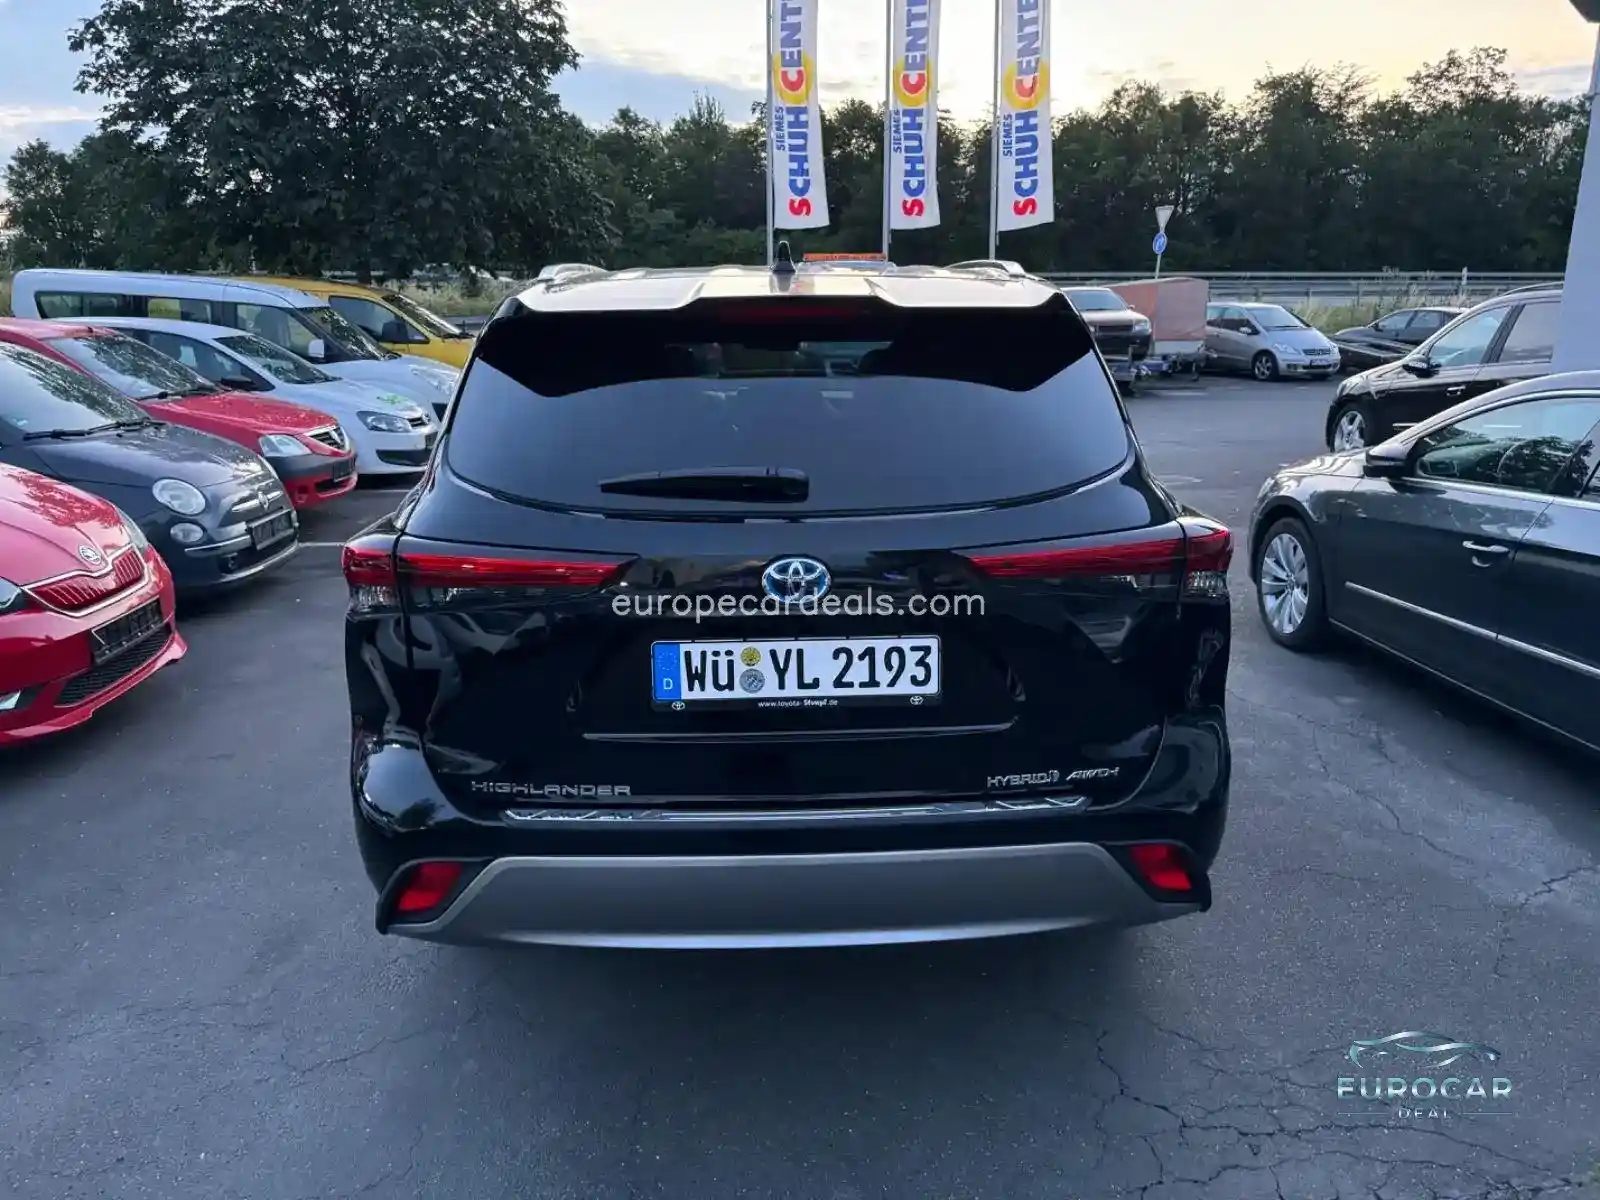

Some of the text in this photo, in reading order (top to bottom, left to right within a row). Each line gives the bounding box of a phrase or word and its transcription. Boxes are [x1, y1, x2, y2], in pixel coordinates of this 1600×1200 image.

[774, 106, 786, 151] SIEMES
[893, 109, 903, 153] SIEMES
[1003, 114, 1013, 157] SIEMES
[662, 678, 674, 690] D
[769, 648, 820, 690] YL
[832, 645, 932, 688] 2193
[471, 780, 631, 797] HIGHLANDER
[987, 773, 1047, 788] HYBRID
